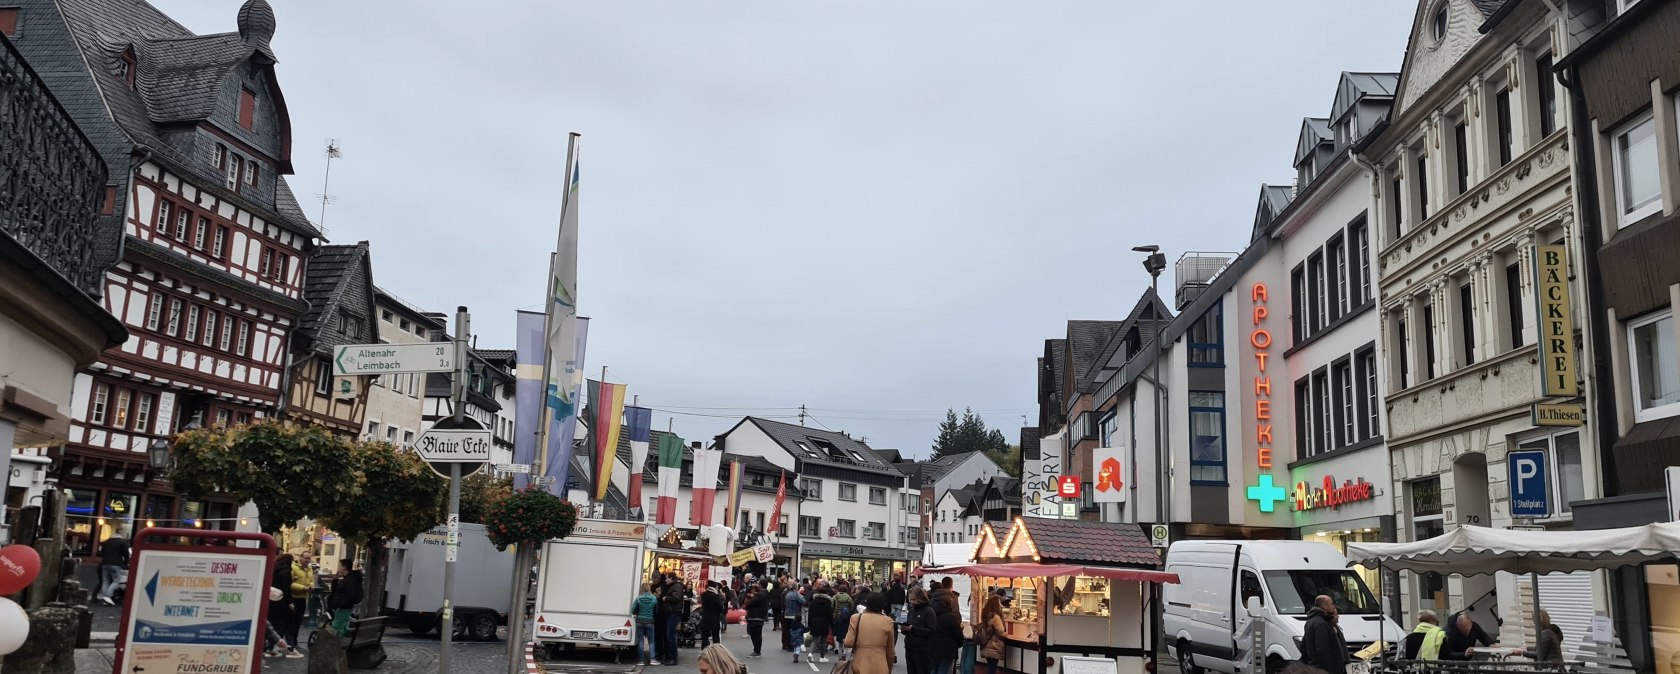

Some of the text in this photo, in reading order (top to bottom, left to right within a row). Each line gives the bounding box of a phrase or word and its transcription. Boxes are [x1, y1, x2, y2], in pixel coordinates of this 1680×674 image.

[1545, 251, 1567, 390] BÄCKEREI
[358, 347, 445, 358] Altenahr 20
[357, 361, 400, 370] Leimbach
[1251, 283, 1272, 468] APOTHEKE
[1539, 409, 1580, 421] H.Thiesen
[462, 437, 488, 454] Ecke
[1516, 458, 1537, 495] P
[1027, 471, 1040, 516] ABRY
[1323, 475, 1371, 511] Apotheke
[1518, 500, 1544, 510] Stellplatz
[1466, 515, 1480, 523] 70
[211, 562, 238, 574] DESIGN
[161, 576, 215, 588] WERBETECHNIK
[217, 592, 243, 603] DRUCK
[164, 605, 200, 617] INTERNET
[177, 664, 240, 673] FUNDGRUBE
